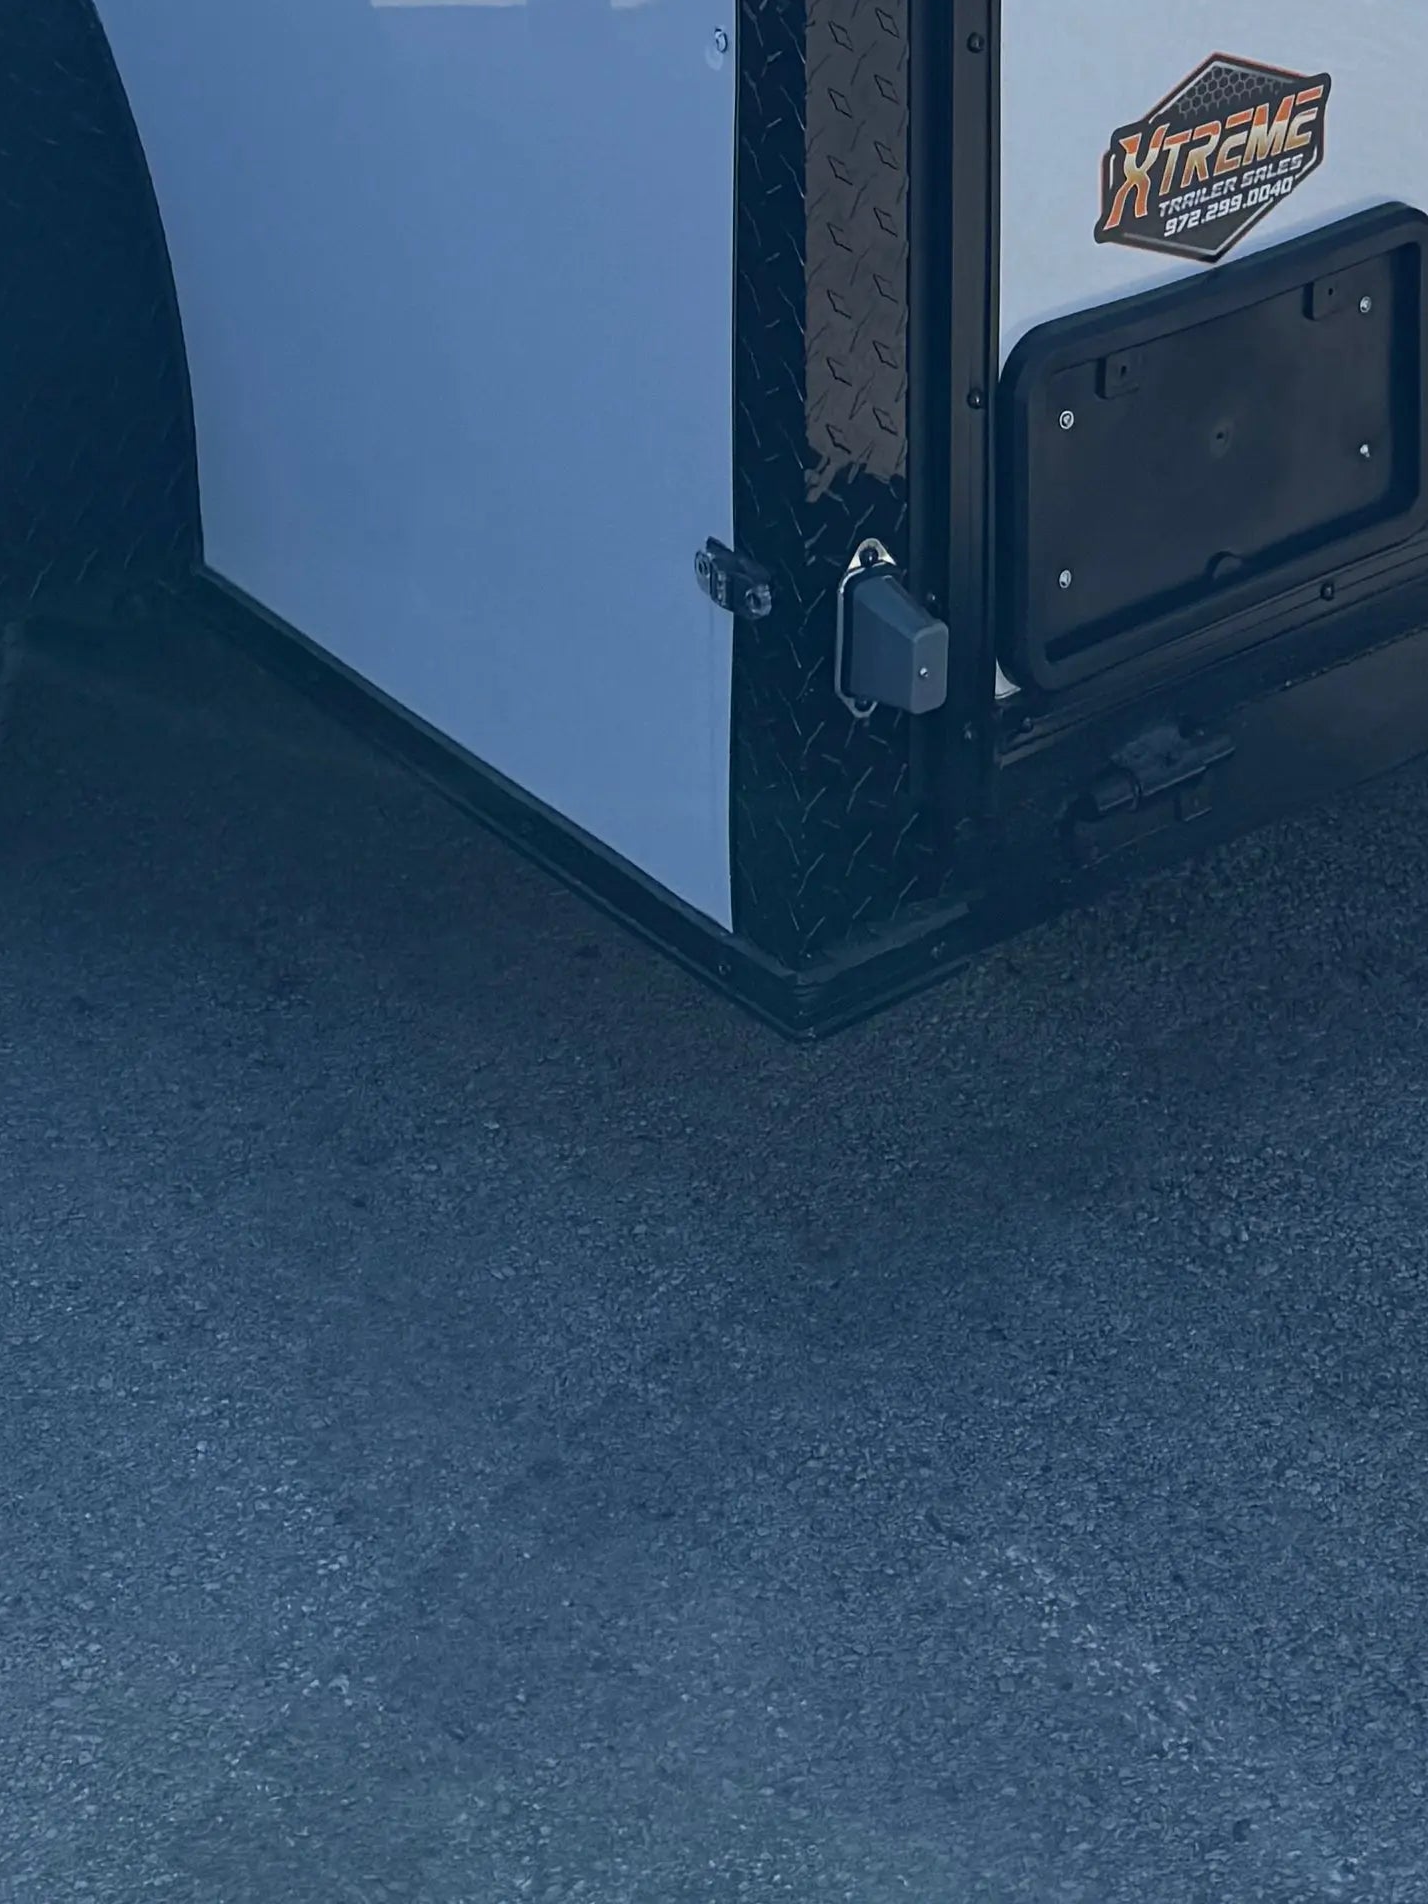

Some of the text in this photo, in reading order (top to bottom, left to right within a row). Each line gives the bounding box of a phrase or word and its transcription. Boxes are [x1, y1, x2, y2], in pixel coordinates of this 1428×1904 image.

[1103, 84, 1324, 231] XTREME
[1158, 153, 1304, 218] TRAILER SALES
[1163, 175, 1293, 238] 972.299.0040
